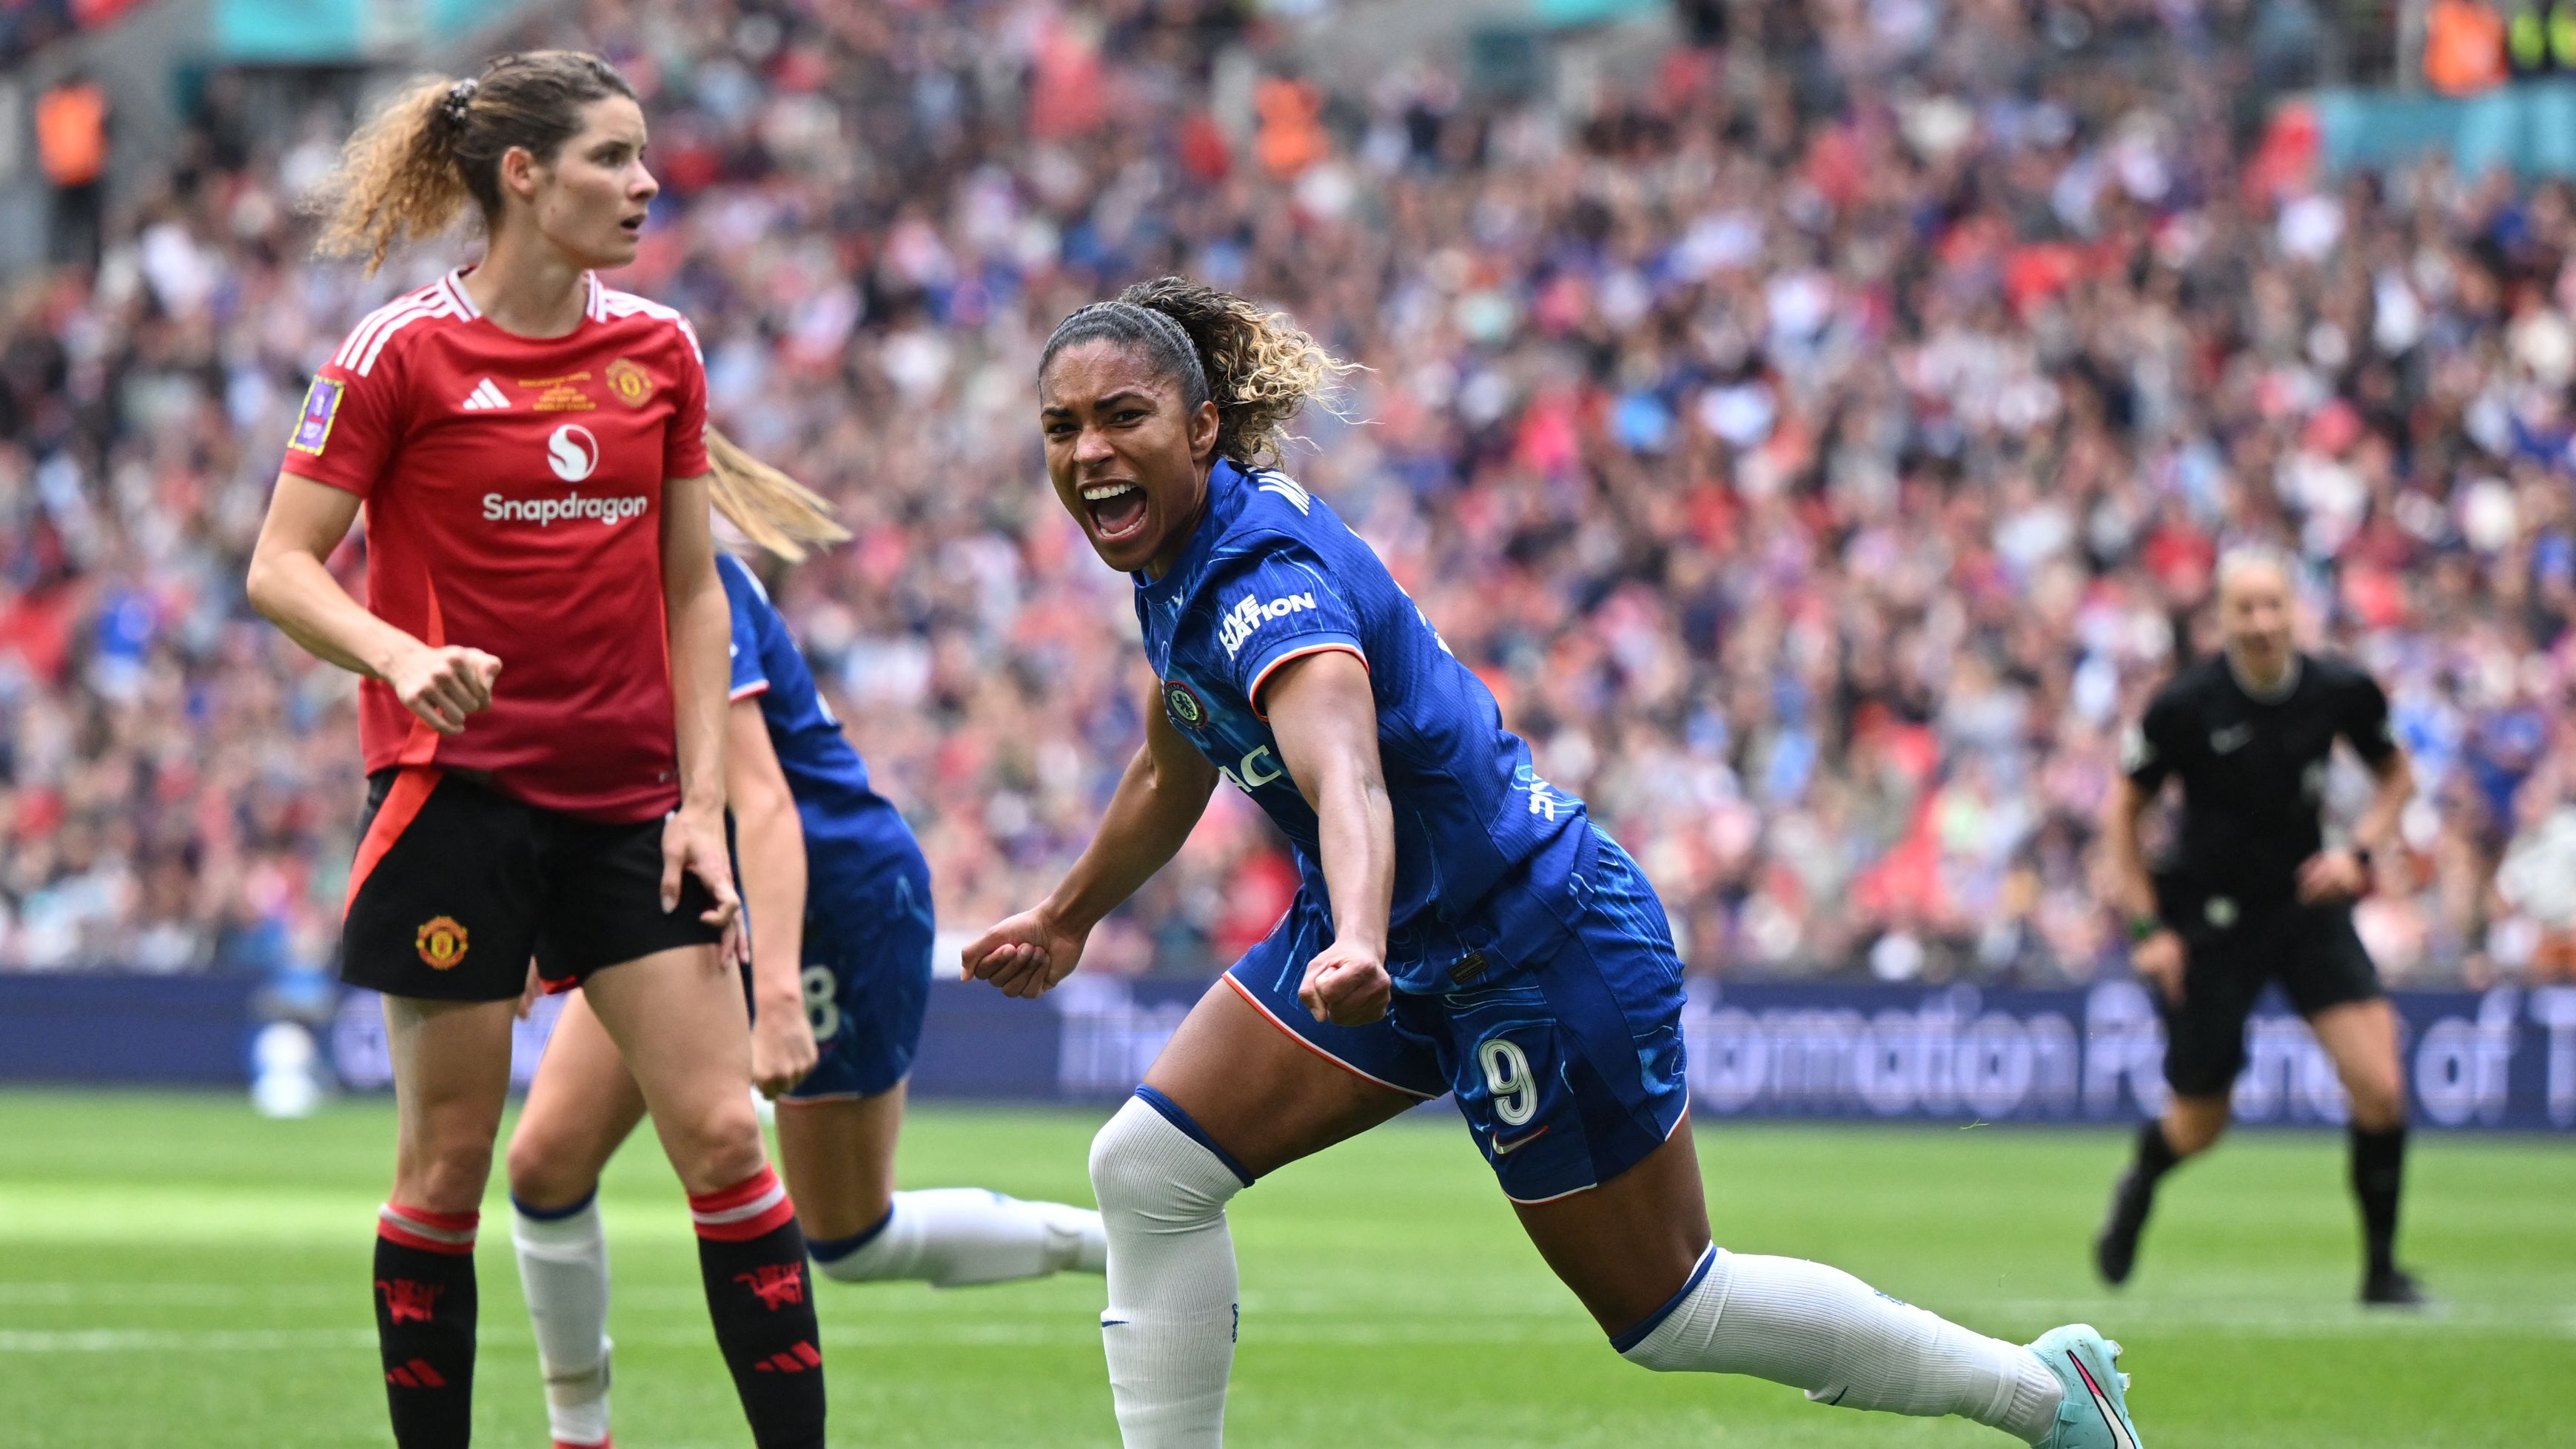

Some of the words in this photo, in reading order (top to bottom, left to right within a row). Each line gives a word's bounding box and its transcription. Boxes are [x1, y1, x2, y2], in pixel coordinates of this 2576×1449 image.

[483, 491, 648, 528] Snapdragon
[1218, 594, 1260, 648] LIVE
[1226, 591, 1317, 662] NATION
[1478, 1038, 1538, 1126] 9
[2412, 981, 2518, 1126] of
